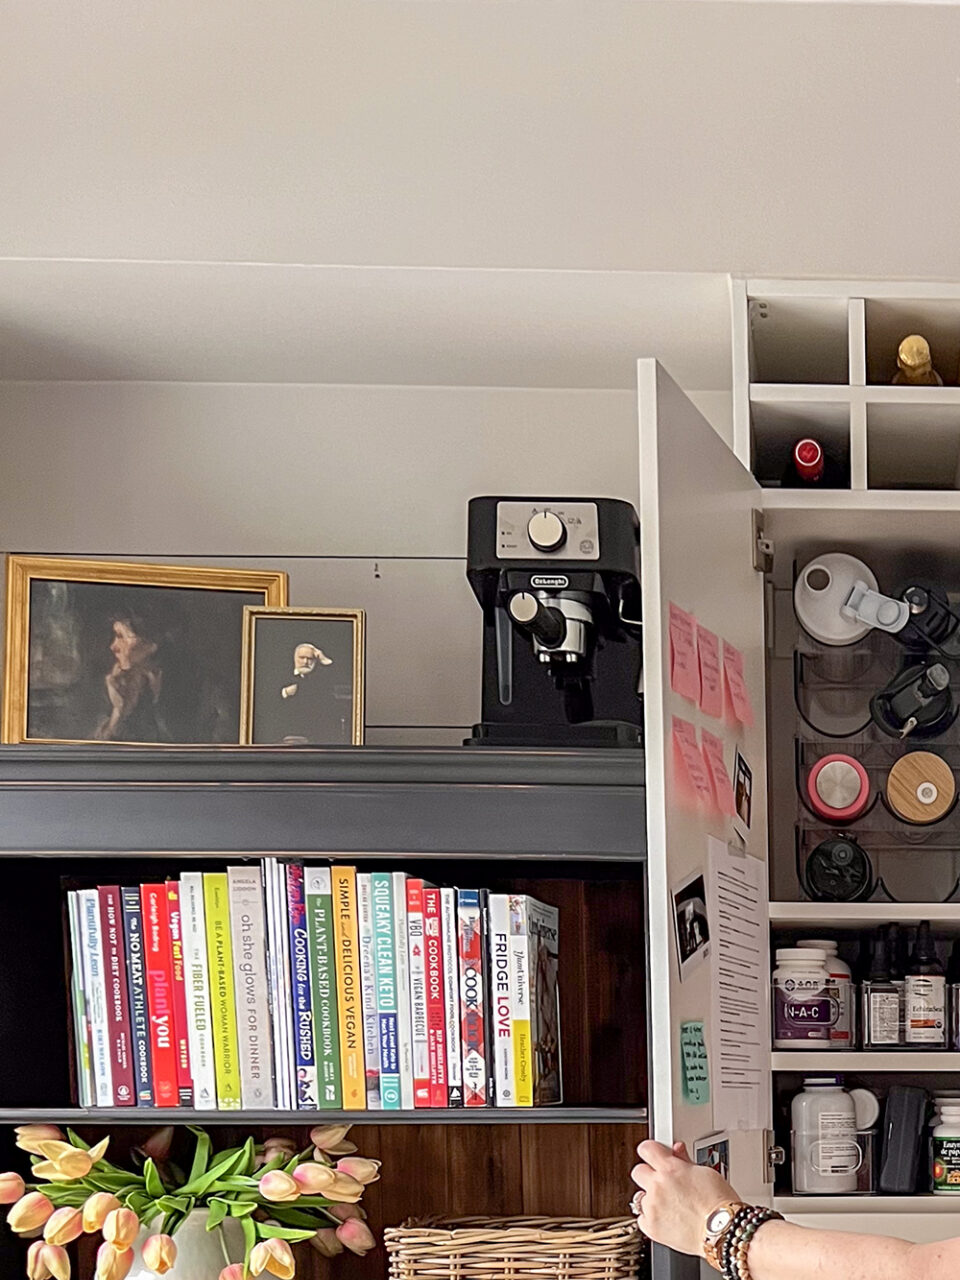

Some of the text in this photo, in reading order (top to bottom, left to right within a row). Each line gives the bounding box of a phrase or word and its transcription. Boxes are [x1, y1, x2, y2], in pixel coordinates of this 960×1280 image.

[107, 907, 116, 925] HOW
[150, 893, 158, 924] Carleigh
[339, 878, 350, 920] SIMPLE
[427, 893, 435, 914] THE
[86, 898, 97, 950] Plantifully
[109, 928, 117, 945] NOT
[129, 933, 140, 952] NO
[215, 921, 222, 930] BE
[373, 880, 394, 1006] SQUEAKY CLEAN KETO
[90, 953, 99, 976] Lean
[111, 957, 119, 976] DIET
[169, 912, 183, 981] Vegan Fast Food
[314, 909, 330, 997] PLANT-BASED
[130, 953, 143, 985] MEAT
[192, 964, 204, 991] FIBER
[216, 940, 226, 997] PLANT-BASED
[342, 939, 354, 1001] DELICIOUS
[428, 940, 439, 999] COOKBOOK
[465, 967, 478, 1008] COOK
[495, 933, 510, 1038] FRIDGE LOVE
[114, 978, 123, 1021] COOKBOOK
[133, 987, 145, 1037] ATHLETE
[193, 995, 206, 1031] FUELED
[220, 1000, 228, 1033] WOMAN
[239, 915, 260, 1079] oh she glows FOR DINNER
[362, 936, 376, 1055] Dreena's Kind Kitchen
[414, 978, 425, 1036] VEGAN BARBECUE
[321, 1000, 332, 1056] COOKBOOK
[346, 1007, 356, 1049] VEGAN
[138, 1040, 148, 1083] COOKBOOK
[223, 1035, 231, 1074] WARRIOR
